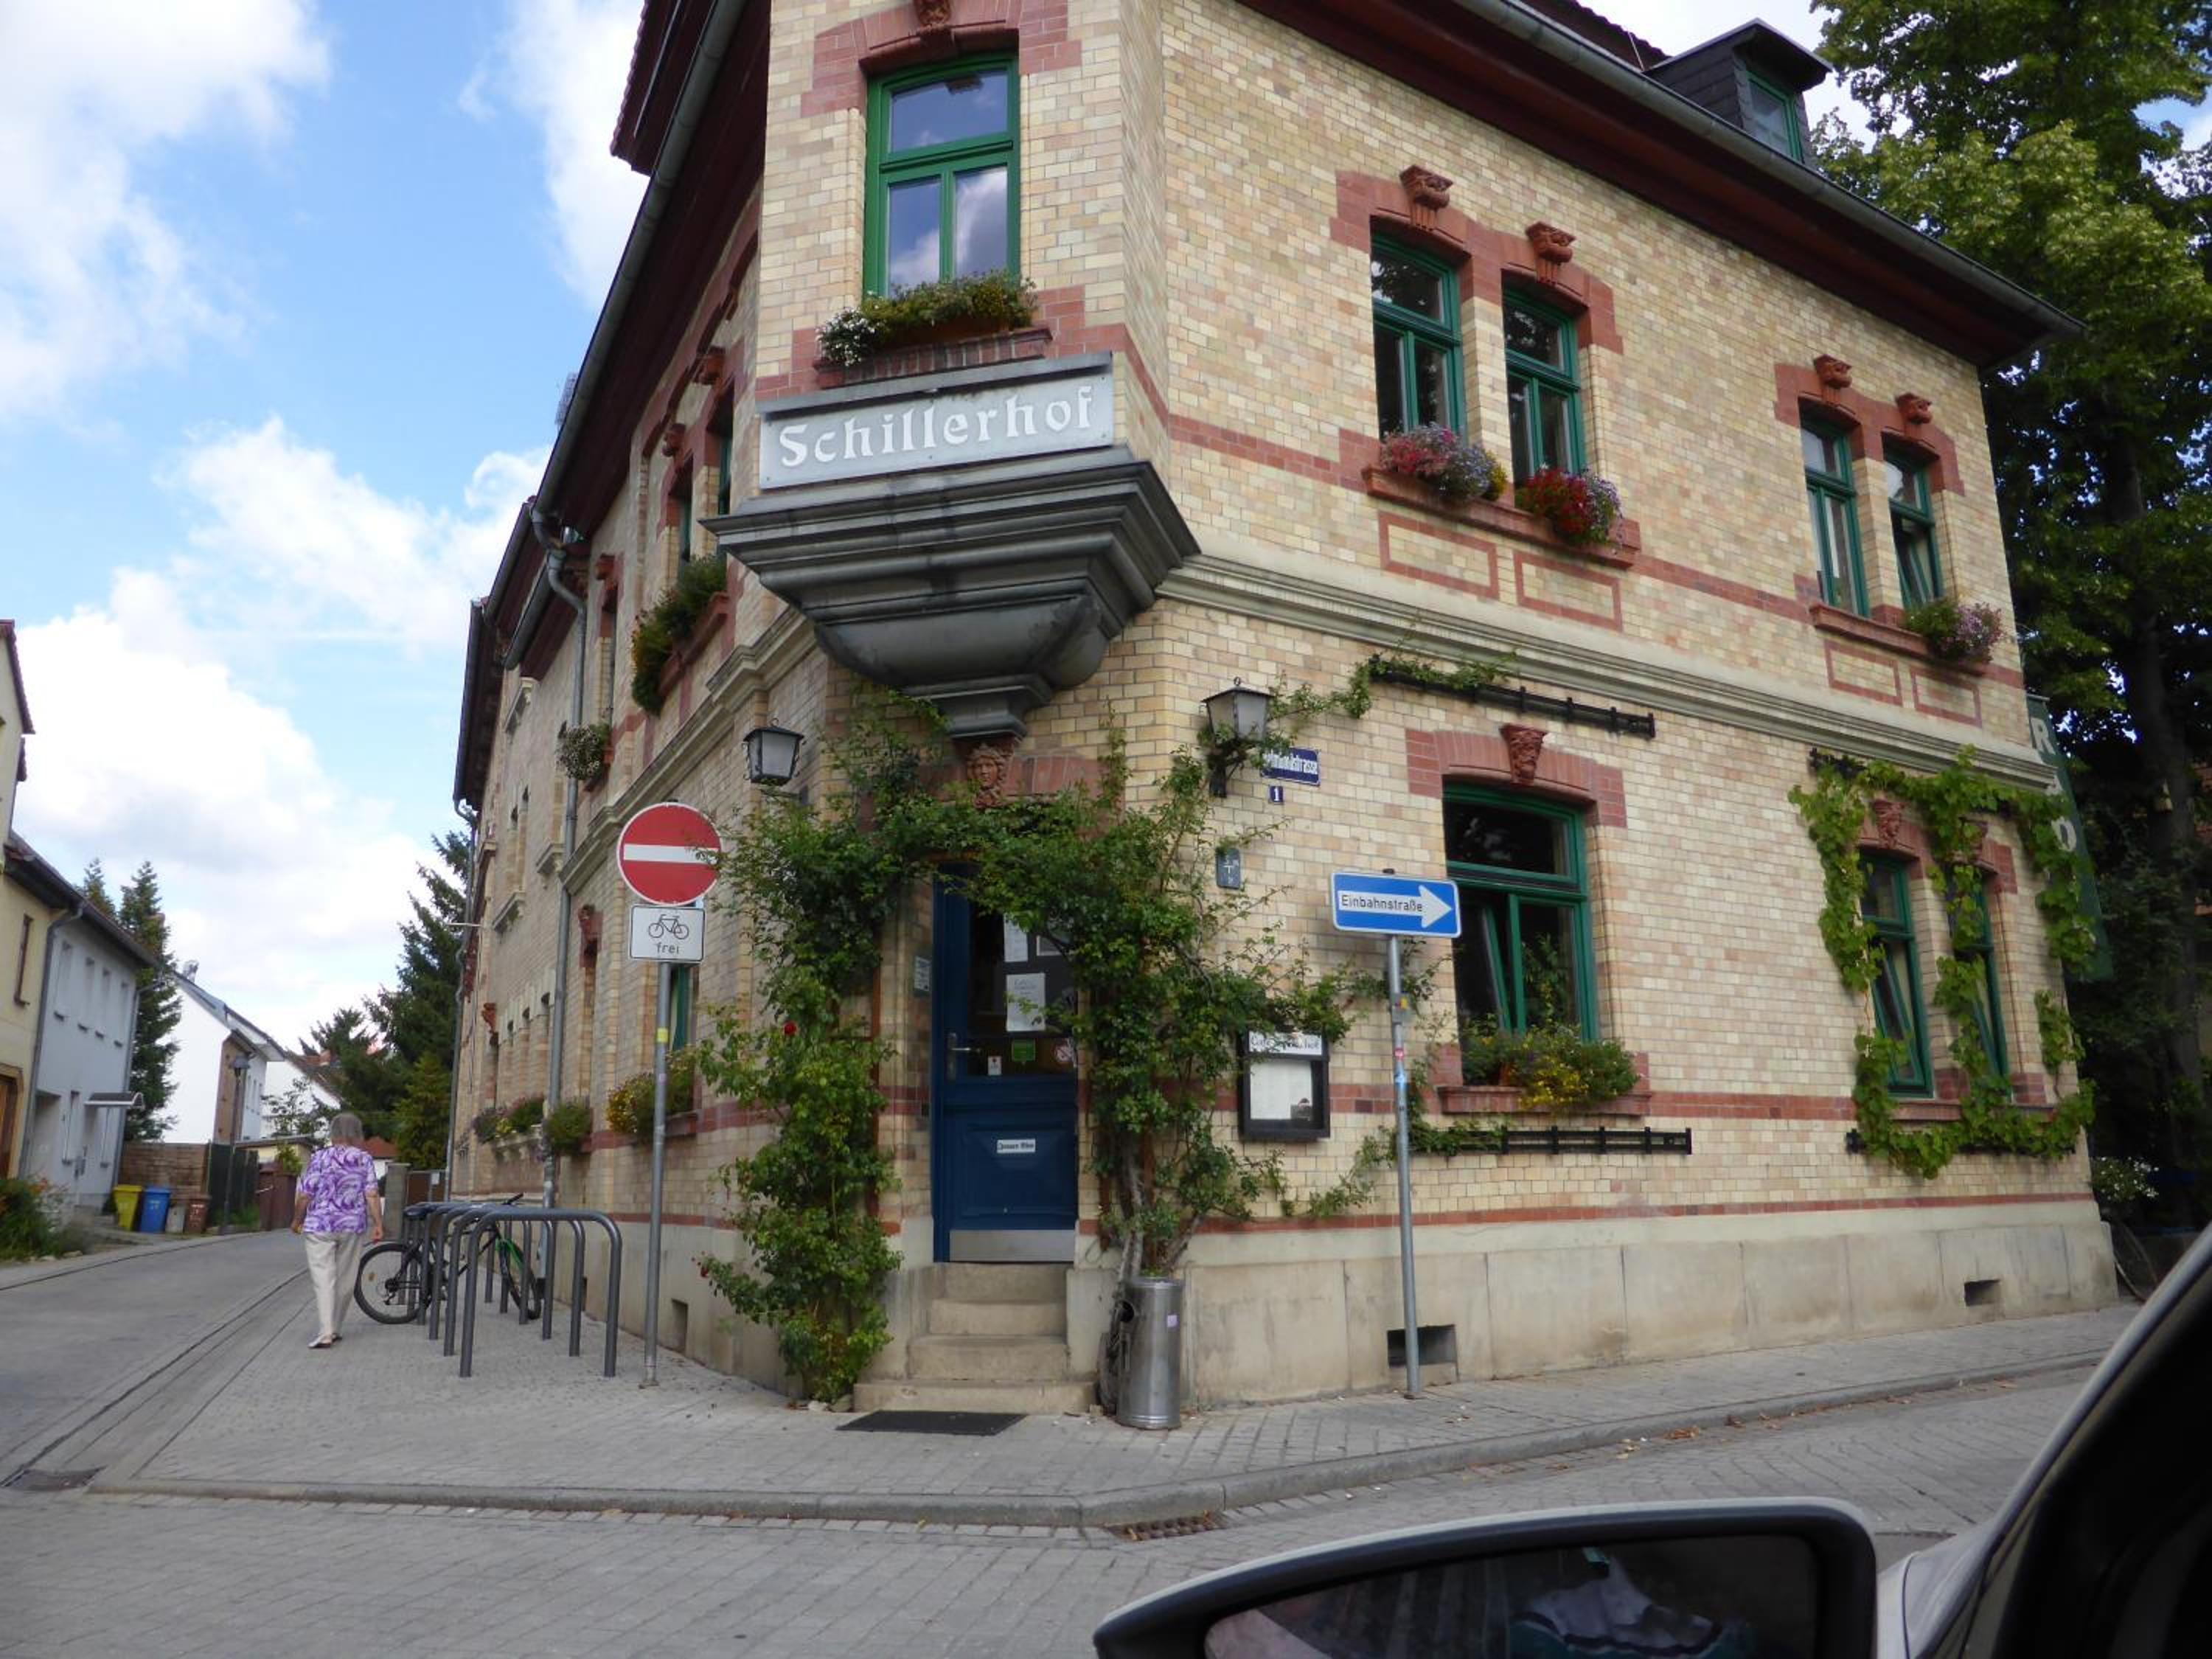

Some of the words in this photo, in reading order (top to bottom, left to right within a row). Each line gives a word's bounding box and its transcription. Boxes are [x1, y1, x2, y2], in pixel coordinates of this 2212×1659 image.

[779, 385, 1093, 468] Schillerhof
[1273, 787, 1280, 801] 1
[1341, 894, 1423, 913] Einbahnstraße
[656, 942, 680, 954] frei
